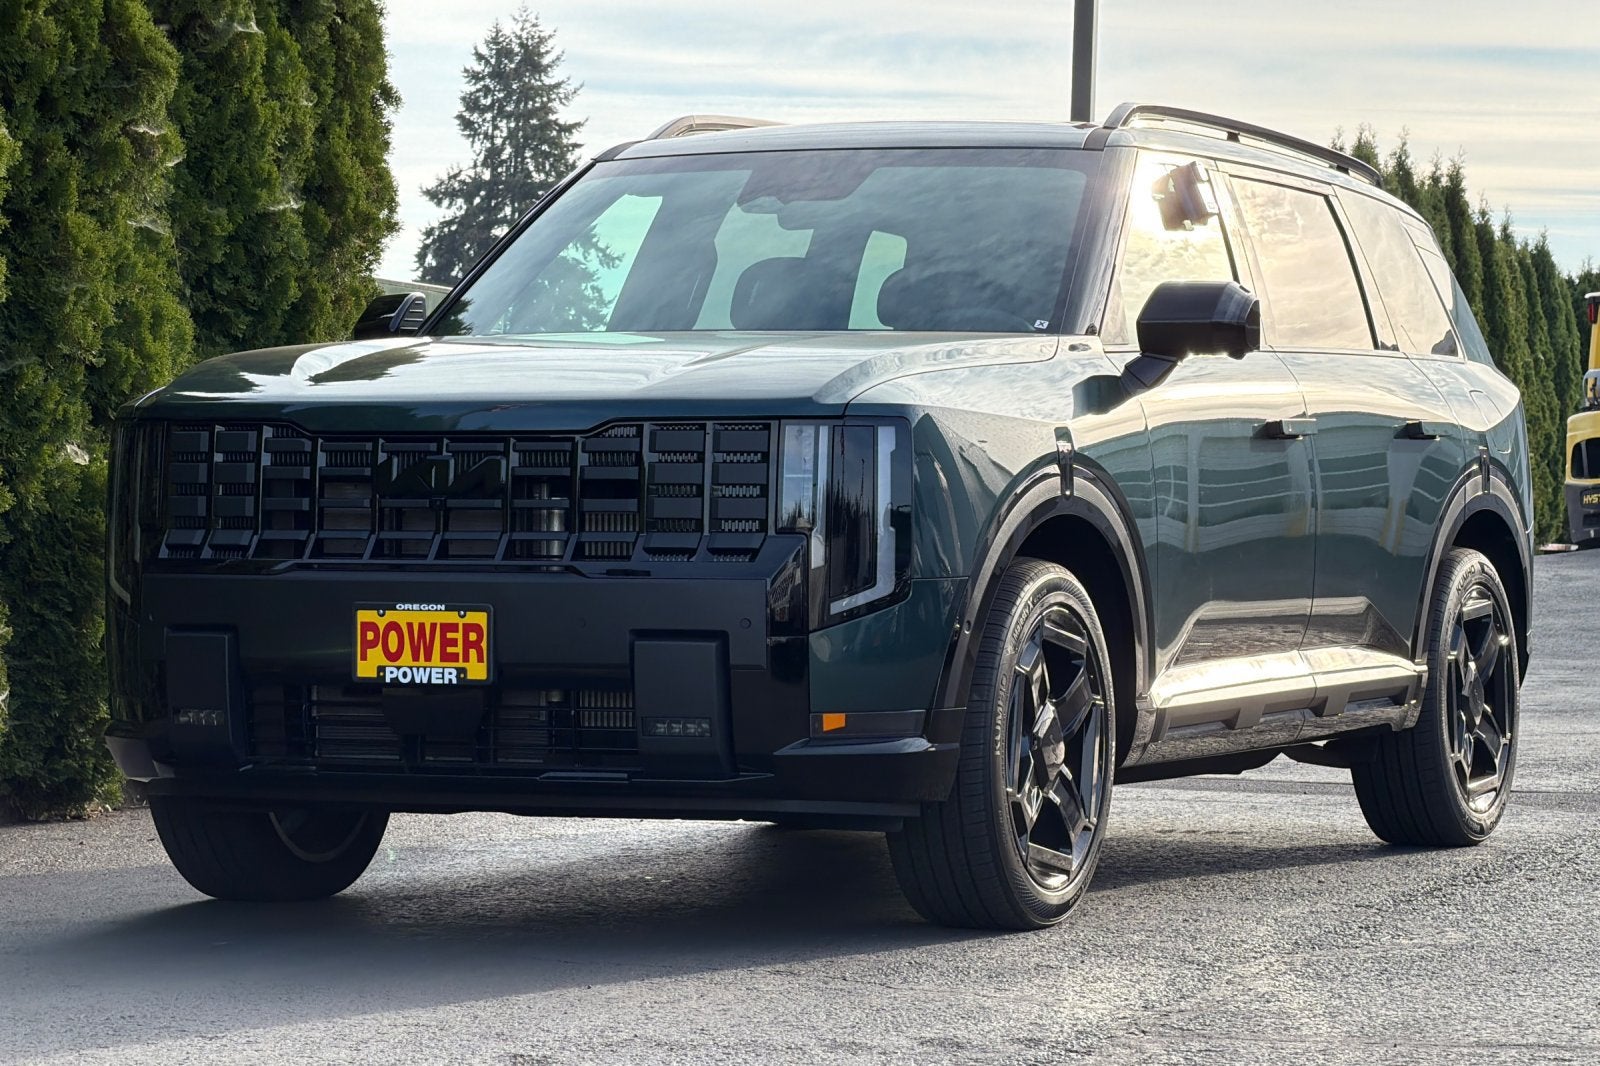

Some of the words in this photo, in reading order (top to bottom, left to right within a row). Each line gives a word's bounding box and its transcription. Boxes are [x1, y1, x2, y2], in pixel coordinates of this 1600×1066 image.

[1456, 564, 1476, 594] KUMHO
[395, 603, 446, 611] OREGON
[360, 621, 485, 663] POWER
[385, 667, 458, 685] POWER
[995, 673, 1008, 755] KUMHO
